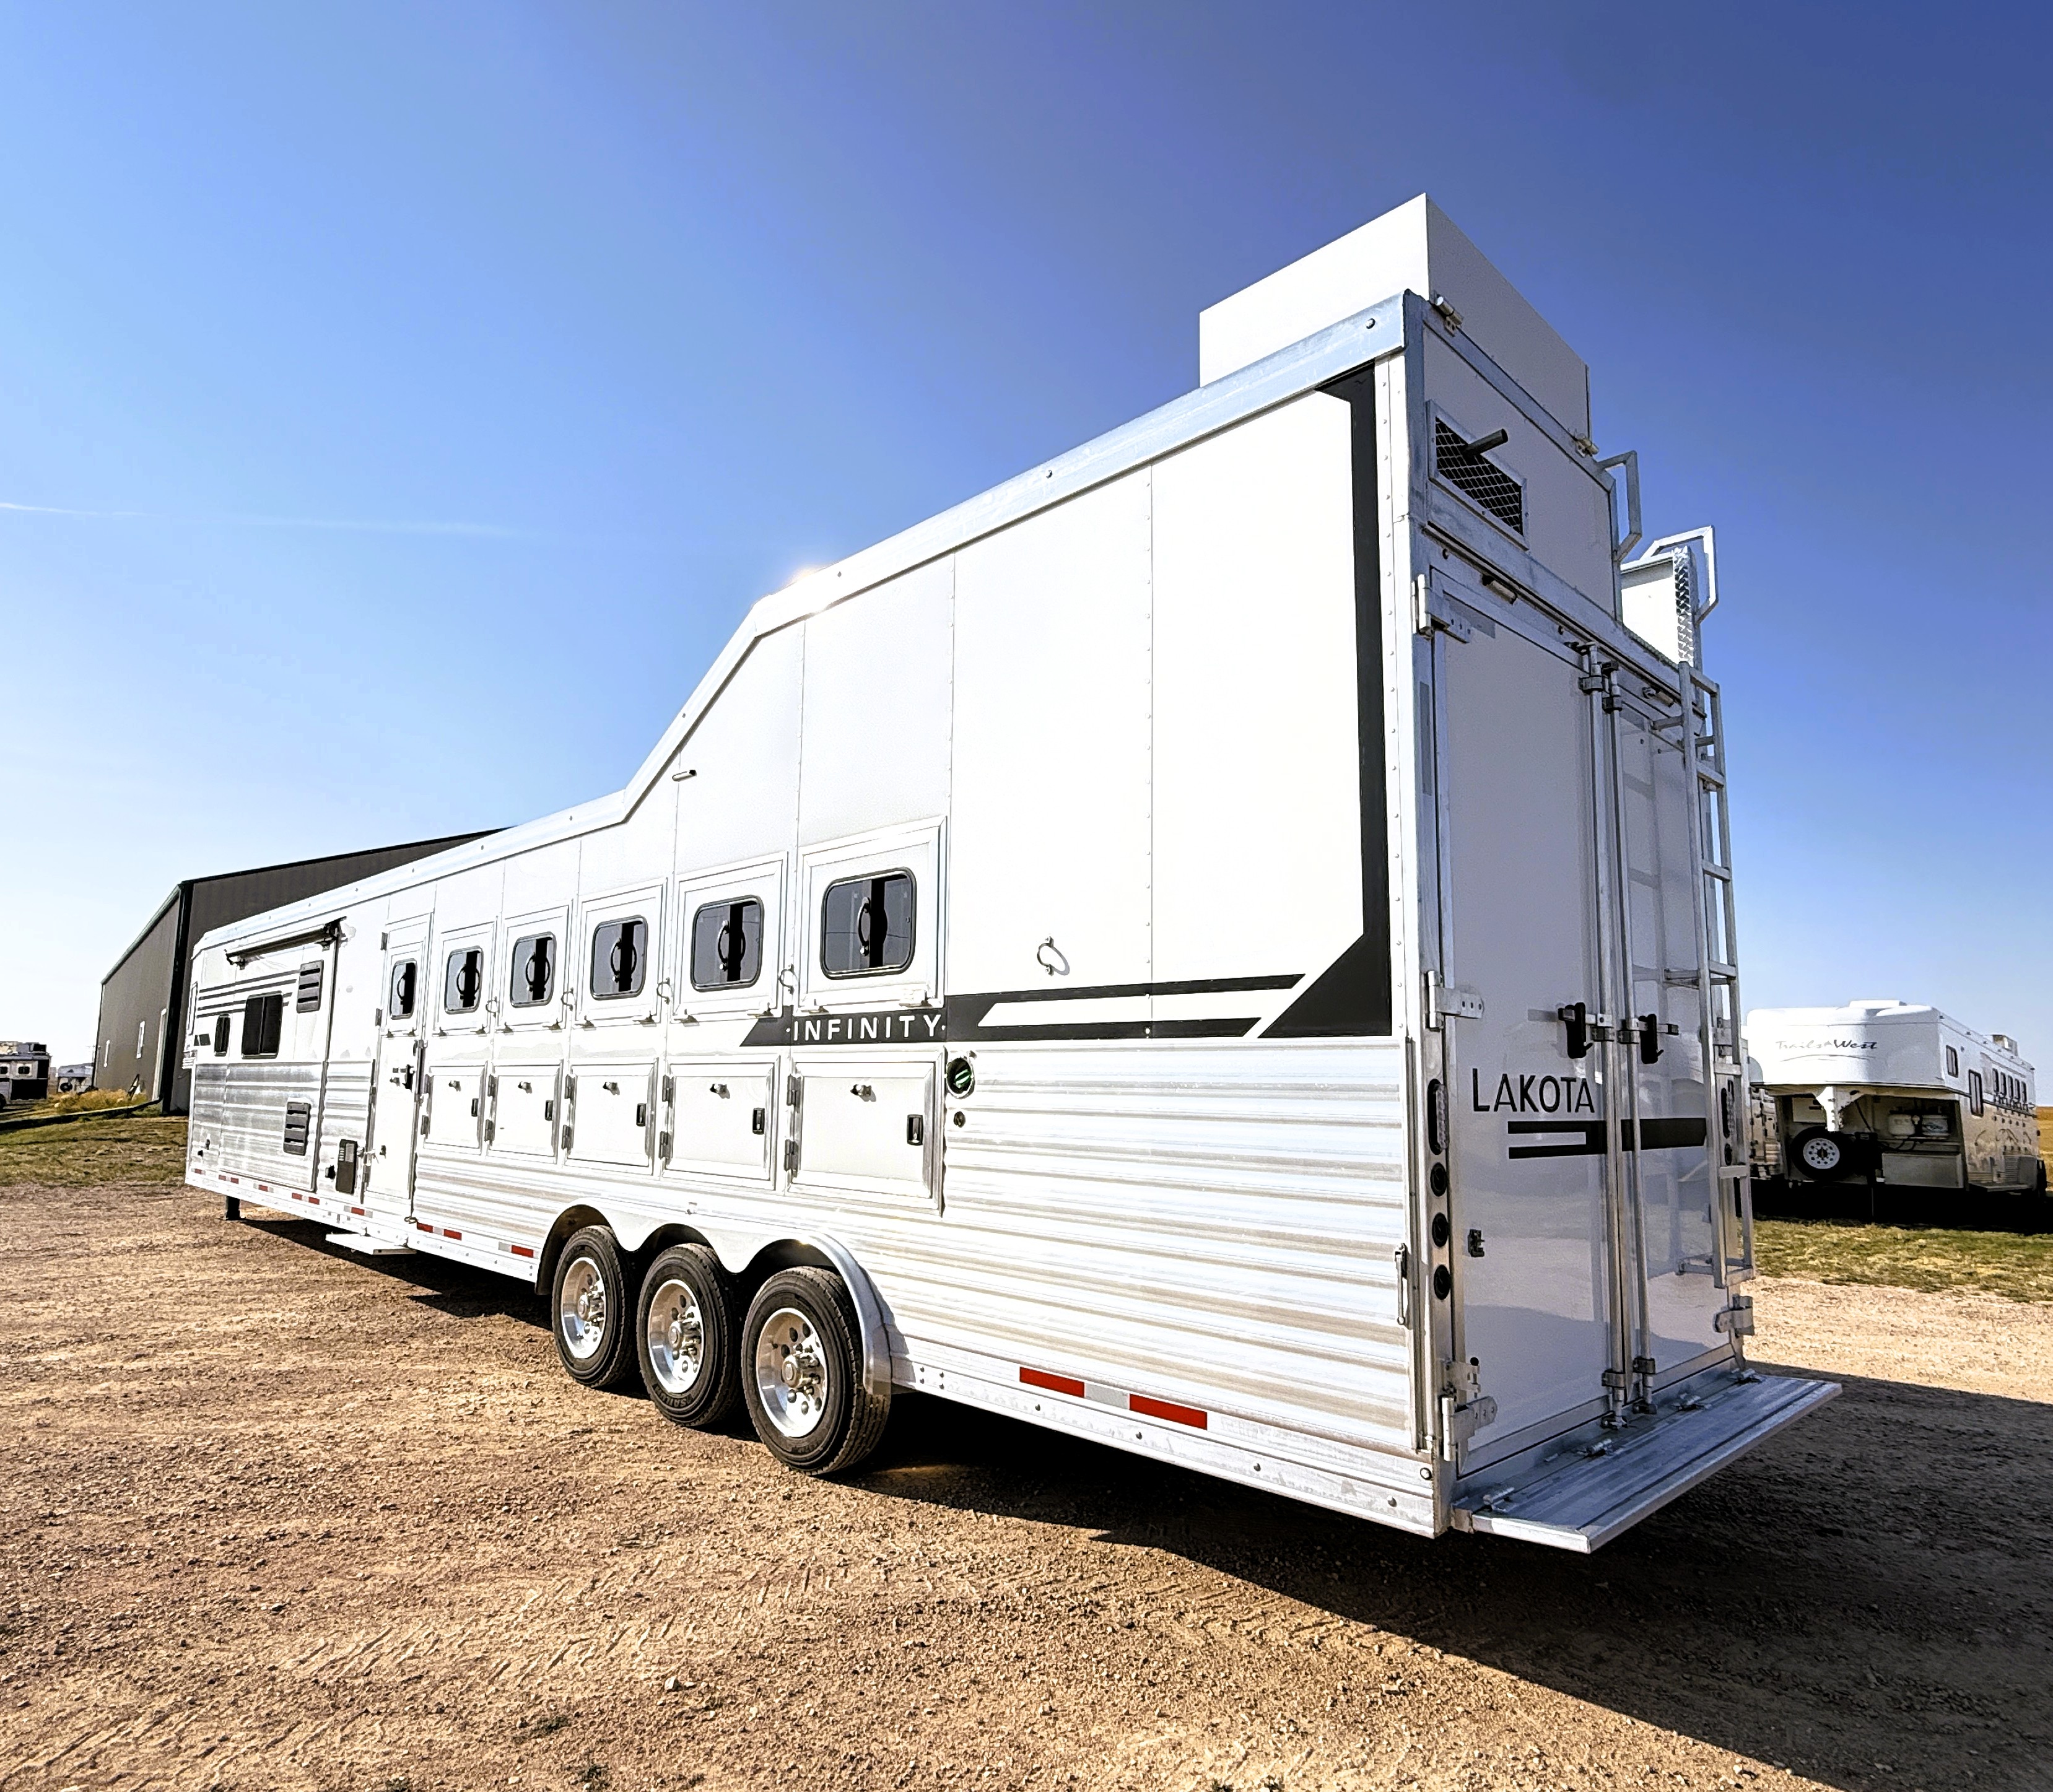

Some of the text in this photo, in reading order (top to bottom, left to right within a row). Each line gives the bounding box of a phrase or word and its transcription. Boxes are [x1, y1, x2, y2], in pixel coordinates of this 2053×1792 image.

[793, 1014, 941, 1041] INFINITY
[1834, 1039, 1878, 1049] West
[1472, 1068, 1595, 1113] LAKOTA
